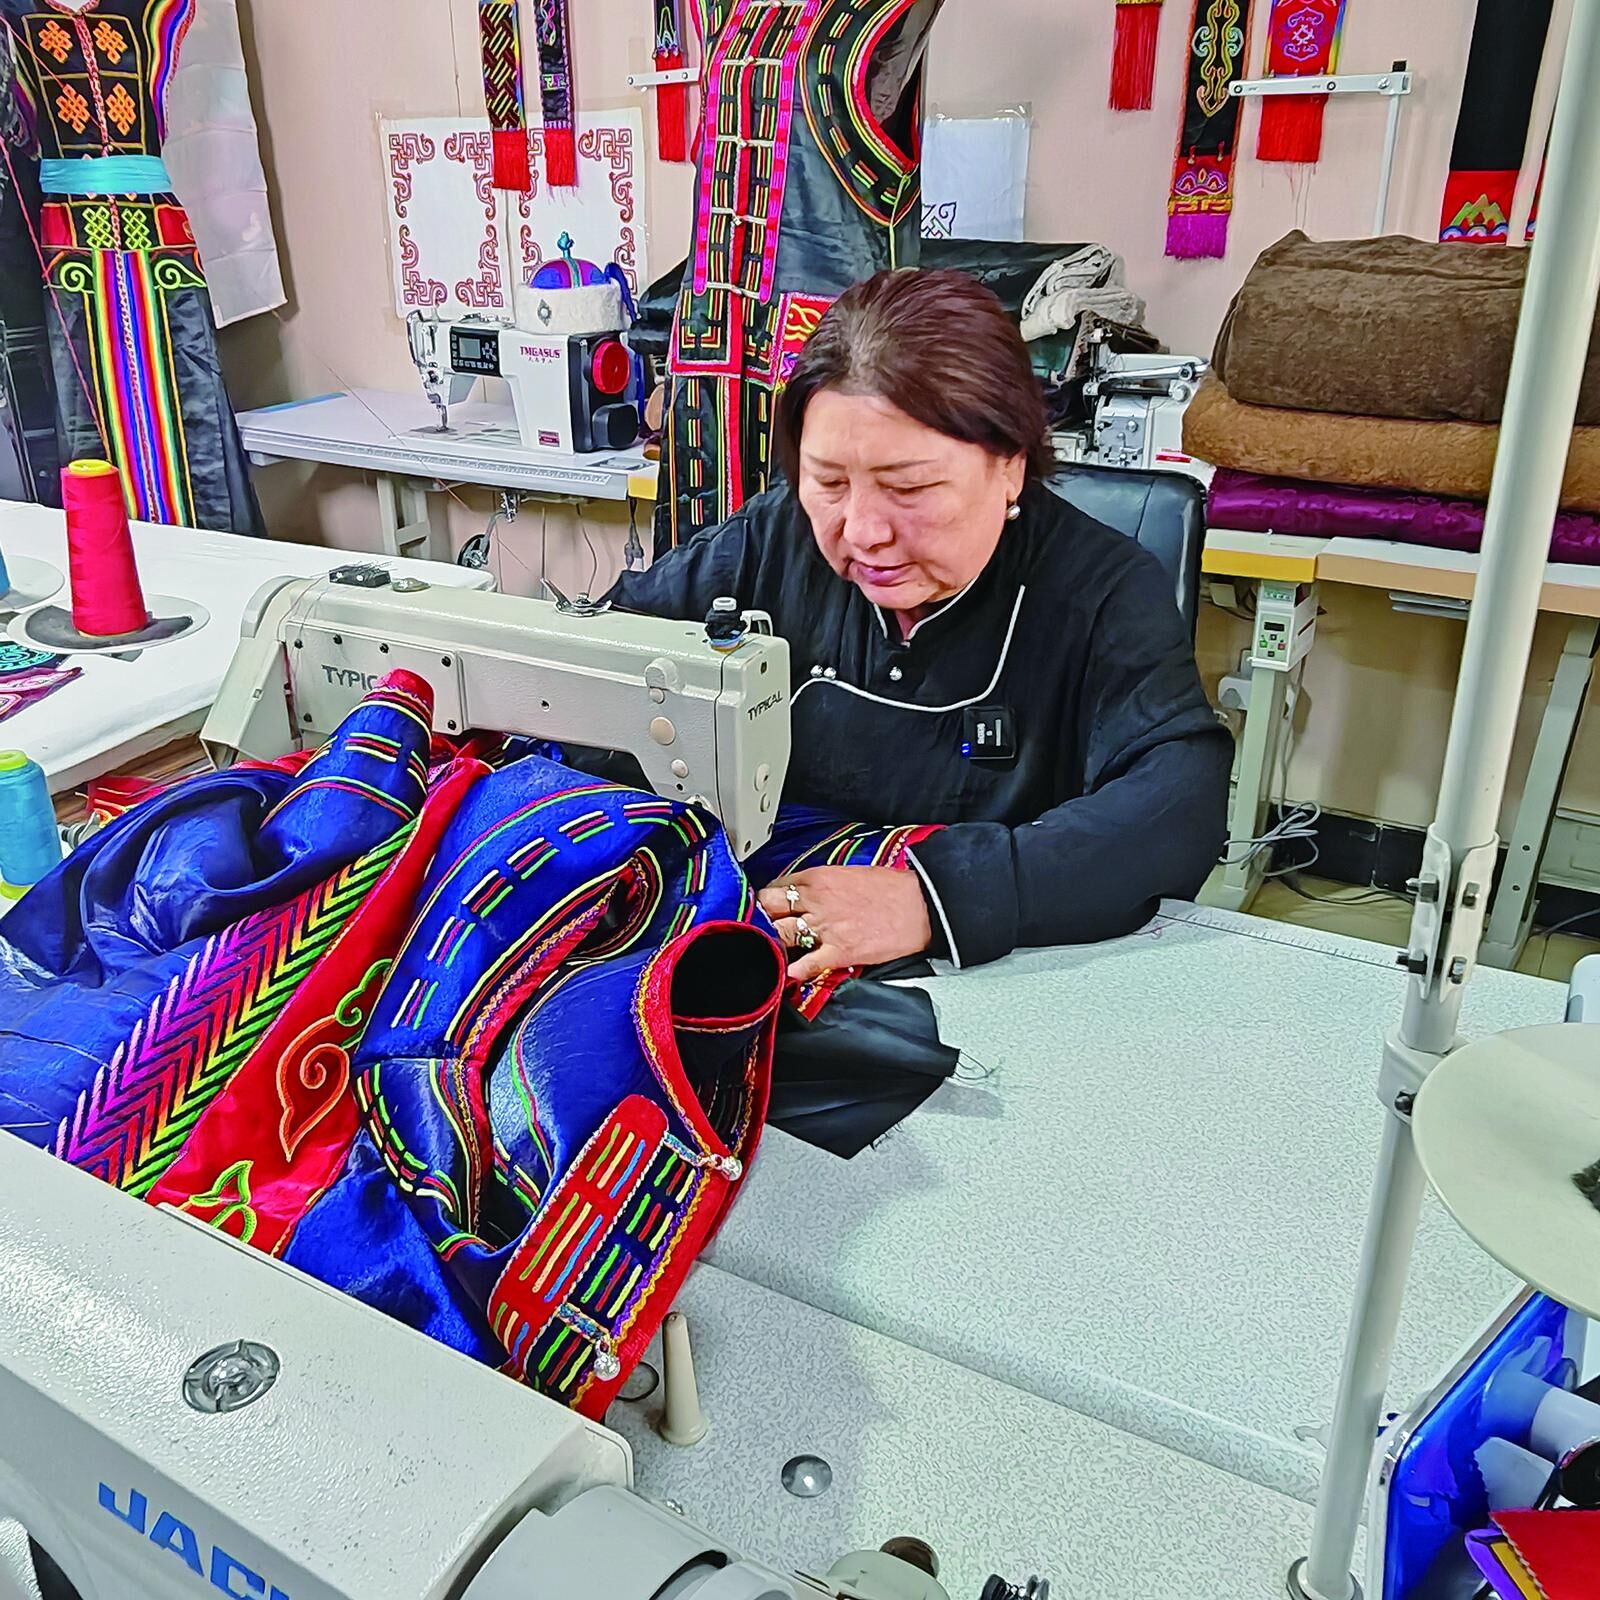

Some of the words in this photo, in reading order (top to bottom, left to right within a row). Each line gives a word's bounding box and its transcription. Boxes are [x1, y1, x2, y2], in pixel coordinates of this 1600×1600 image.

[321, 664, 378, 690] TYPIC
[747, 690, 783, 720] TYPICAL
[99, 1482, 289, 1600] JAC
